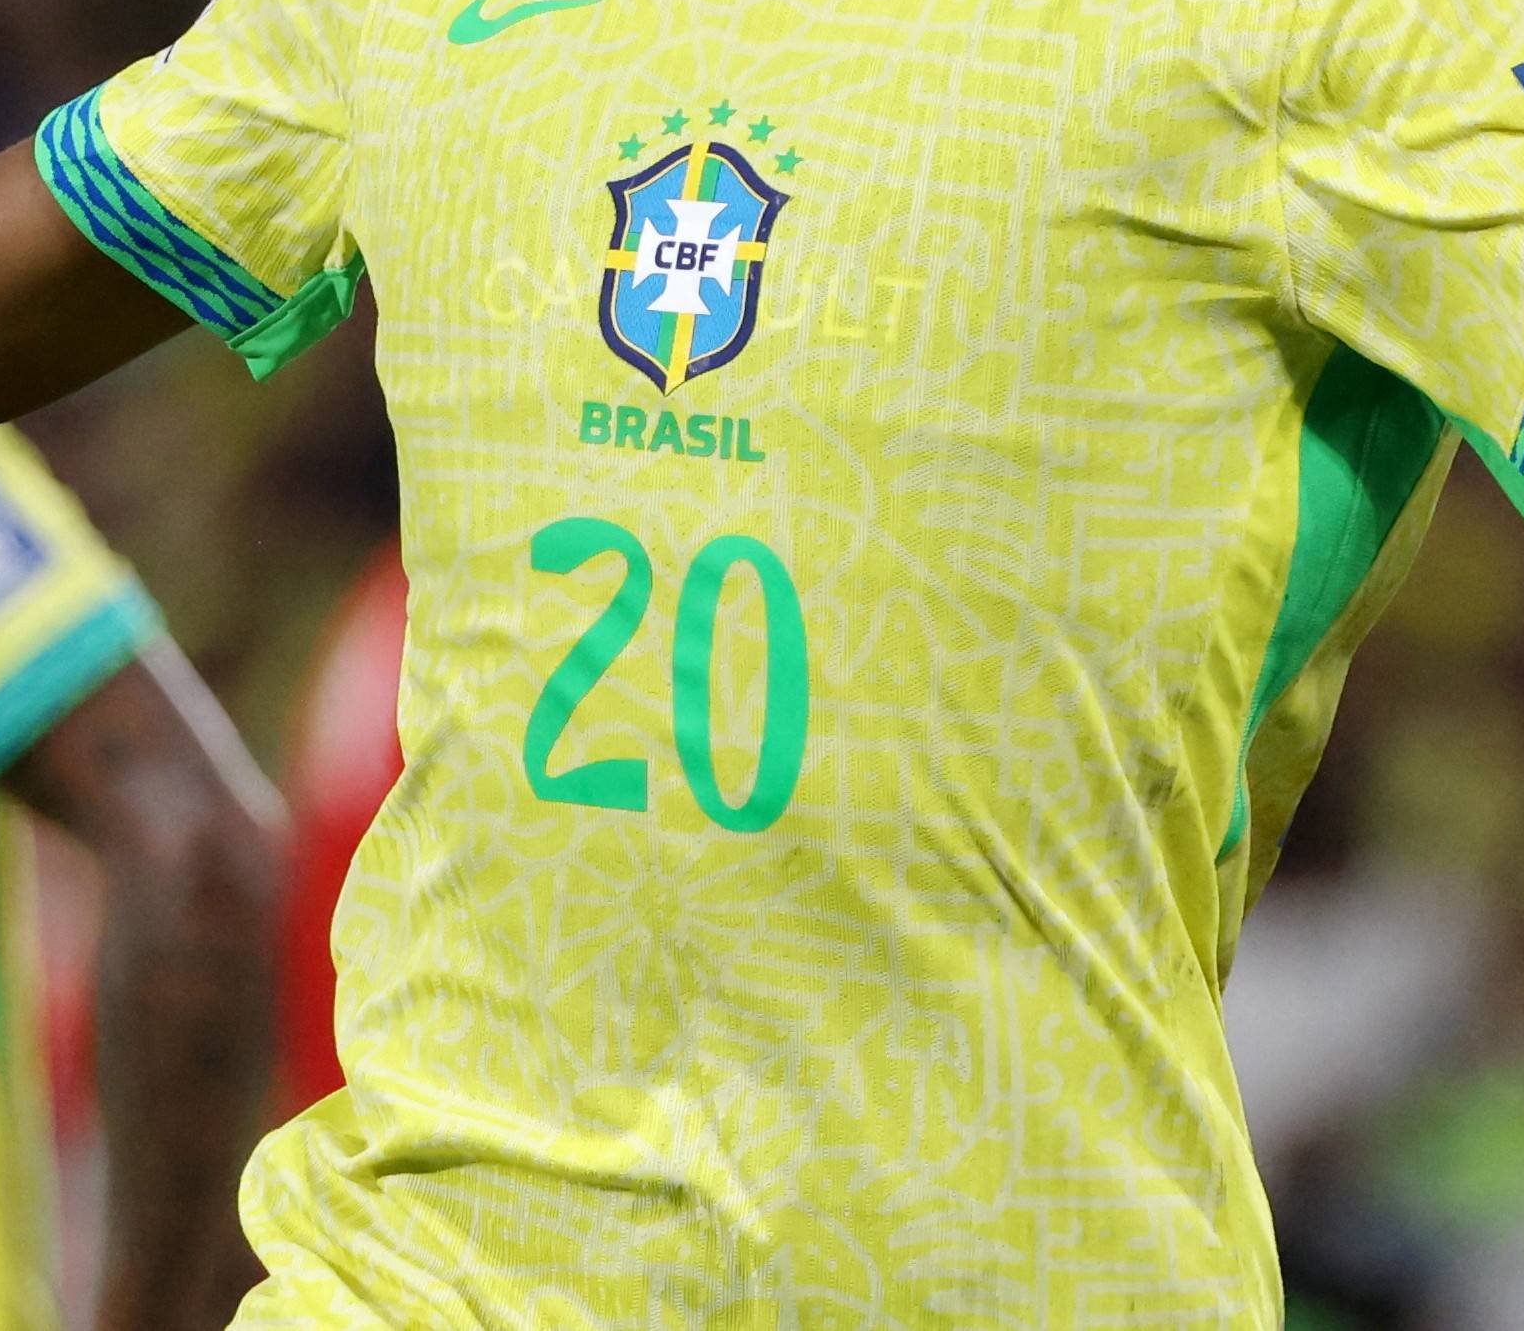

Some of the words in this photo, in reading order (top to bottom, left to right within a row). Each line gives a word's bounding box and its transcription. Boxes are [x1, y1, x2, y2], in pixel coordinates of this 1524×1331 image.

[654, 241, 719, 271] CBF
[483, 256, 928, 343] CAULT
[579, 400, 766, 462] BRASIL
[523, 516, 810, 833] 20
